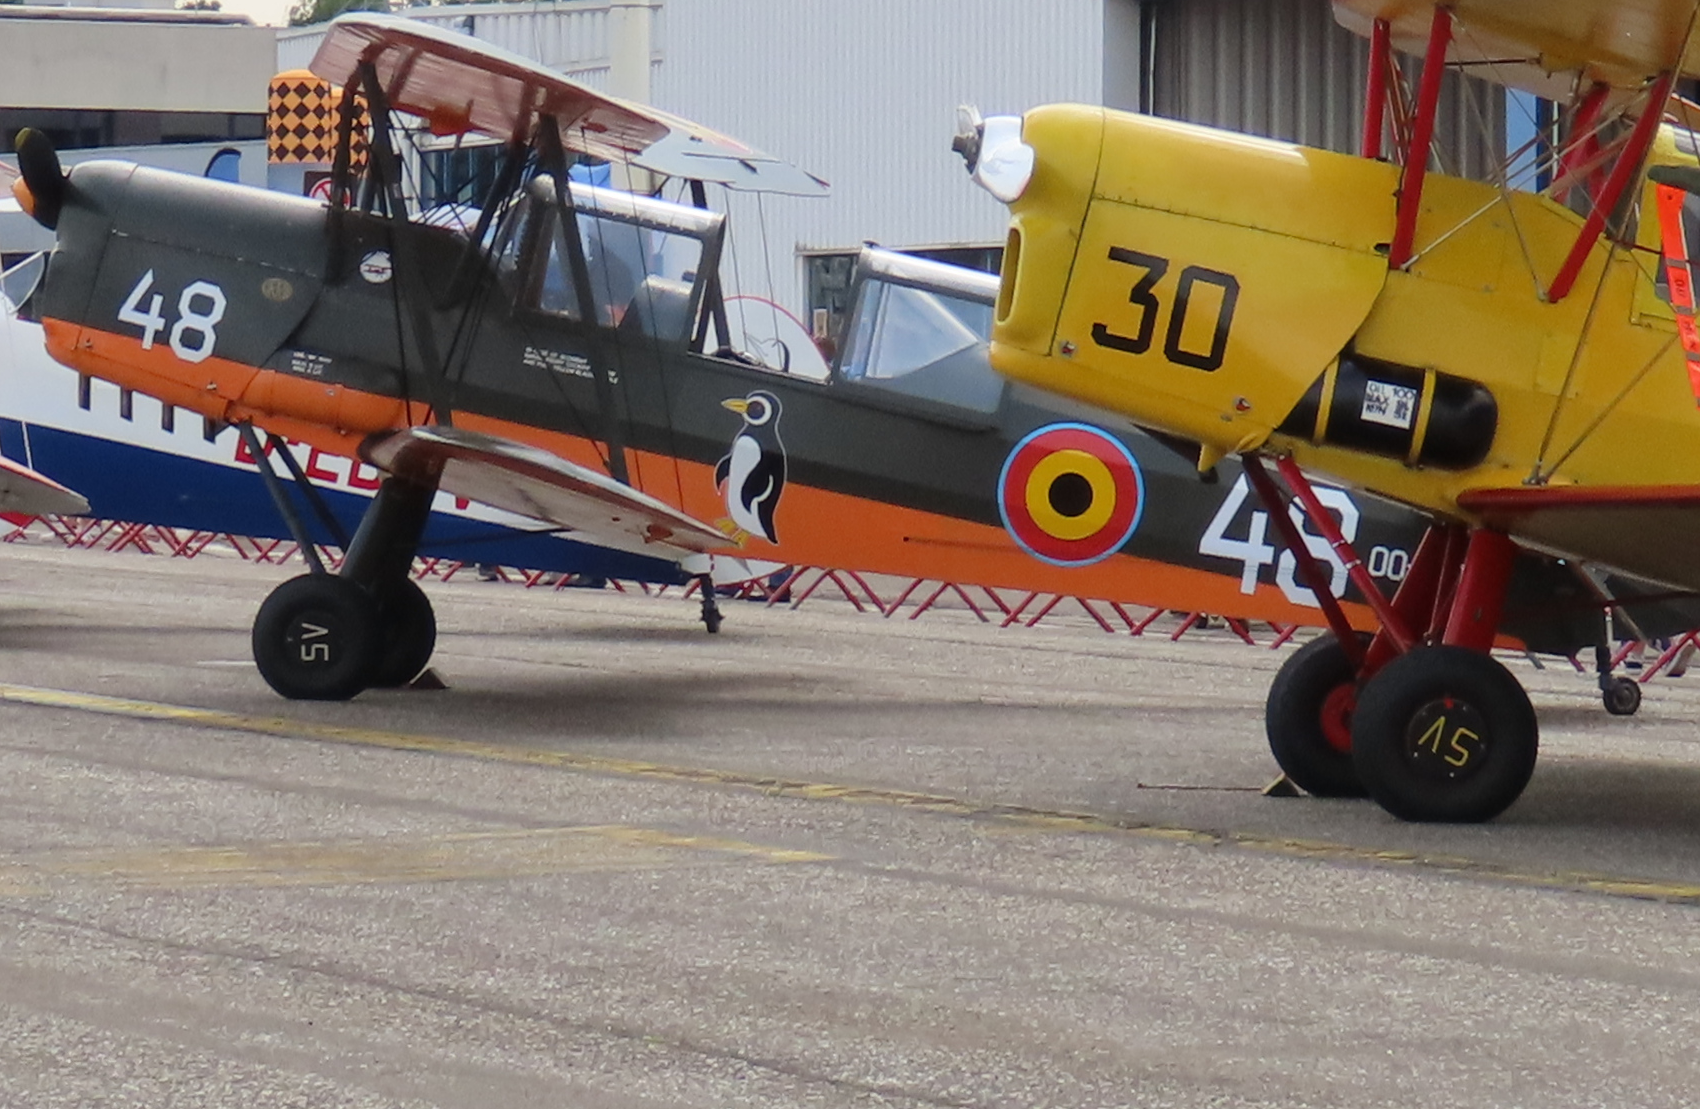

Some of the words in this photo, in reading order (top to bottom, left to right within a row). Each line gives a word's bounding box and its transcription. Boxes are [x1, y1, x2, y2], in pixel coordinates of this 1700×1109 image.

[117, 268, 227, 364] 48
[1091, 246, 1241, 372] 30
[1199, 472, 1360, 610] 48
[301, 622, 329, 662] SV
[1418, 715, 1479, 767] SV
